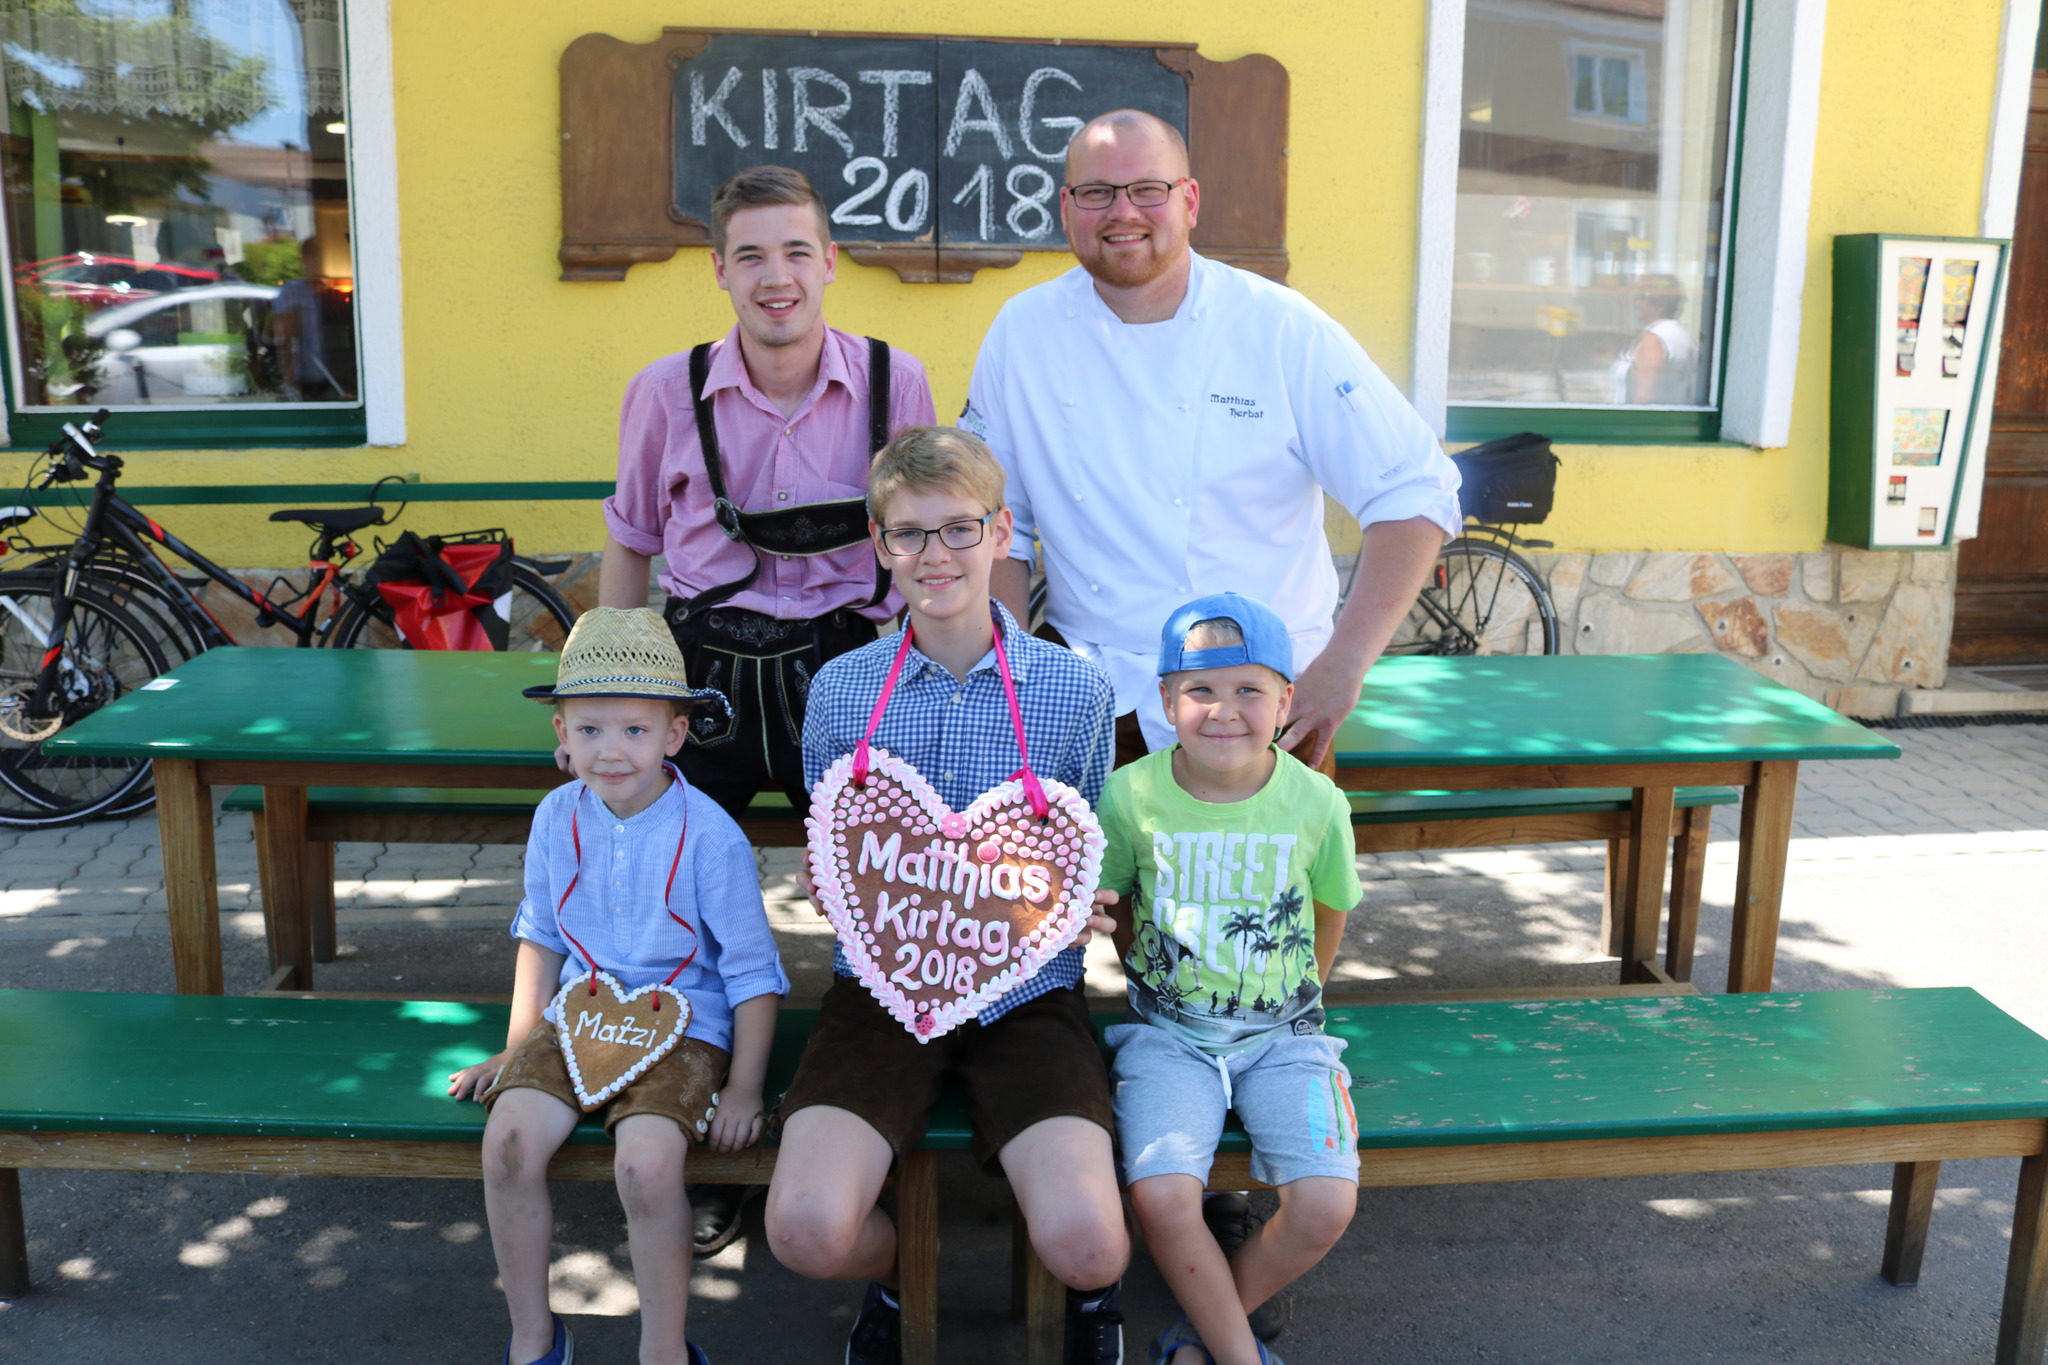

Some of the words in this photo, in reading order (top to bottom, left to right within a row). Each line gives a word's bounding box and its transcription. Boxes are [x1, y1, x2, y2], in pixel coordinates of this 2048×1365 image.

[1210, 393, 1256, 407] Matthias
[1229, 407, 1264, 419] Herbst
[857, 831, 1051, 909] Matthias
[1153, 831, 1298, 904] STREET
[874, 891, 1011, 967] Kirtag
[890, 942, 978, 994] 2018
[574, 1010, 662, 1049] Matzi
